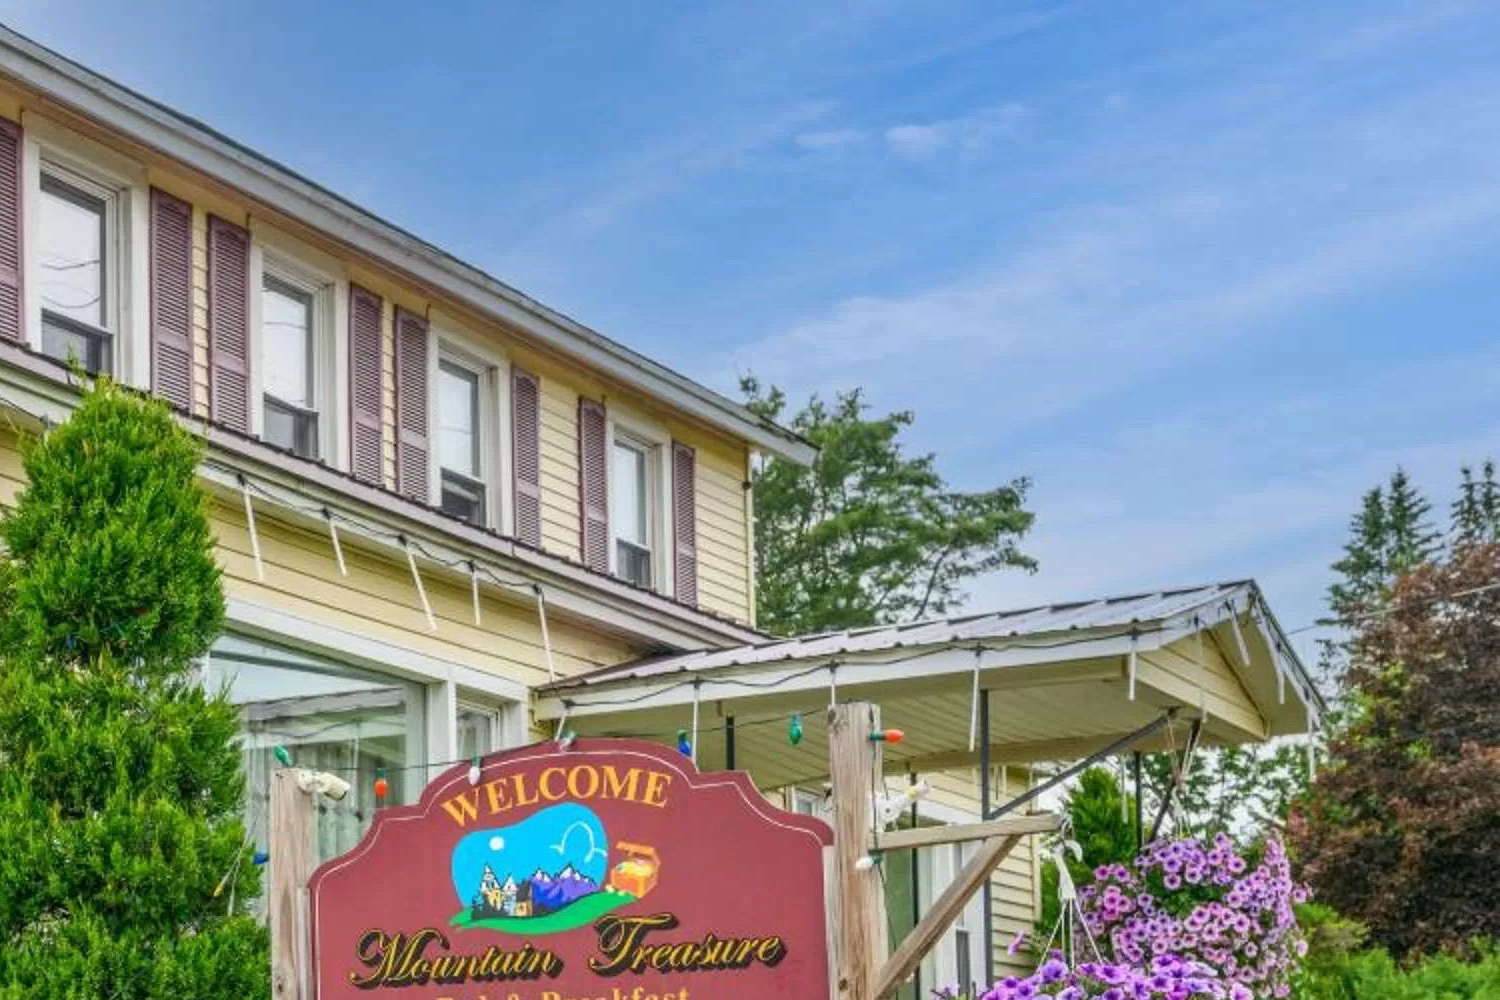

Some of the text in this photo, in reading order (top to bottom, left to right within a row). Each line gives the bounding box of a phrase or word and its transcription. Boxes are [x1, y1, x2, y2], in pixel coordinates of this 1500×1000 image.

[440, 765, 674, 828] WELCOME
[348, 912, 787, 990] Mountain Treasure
